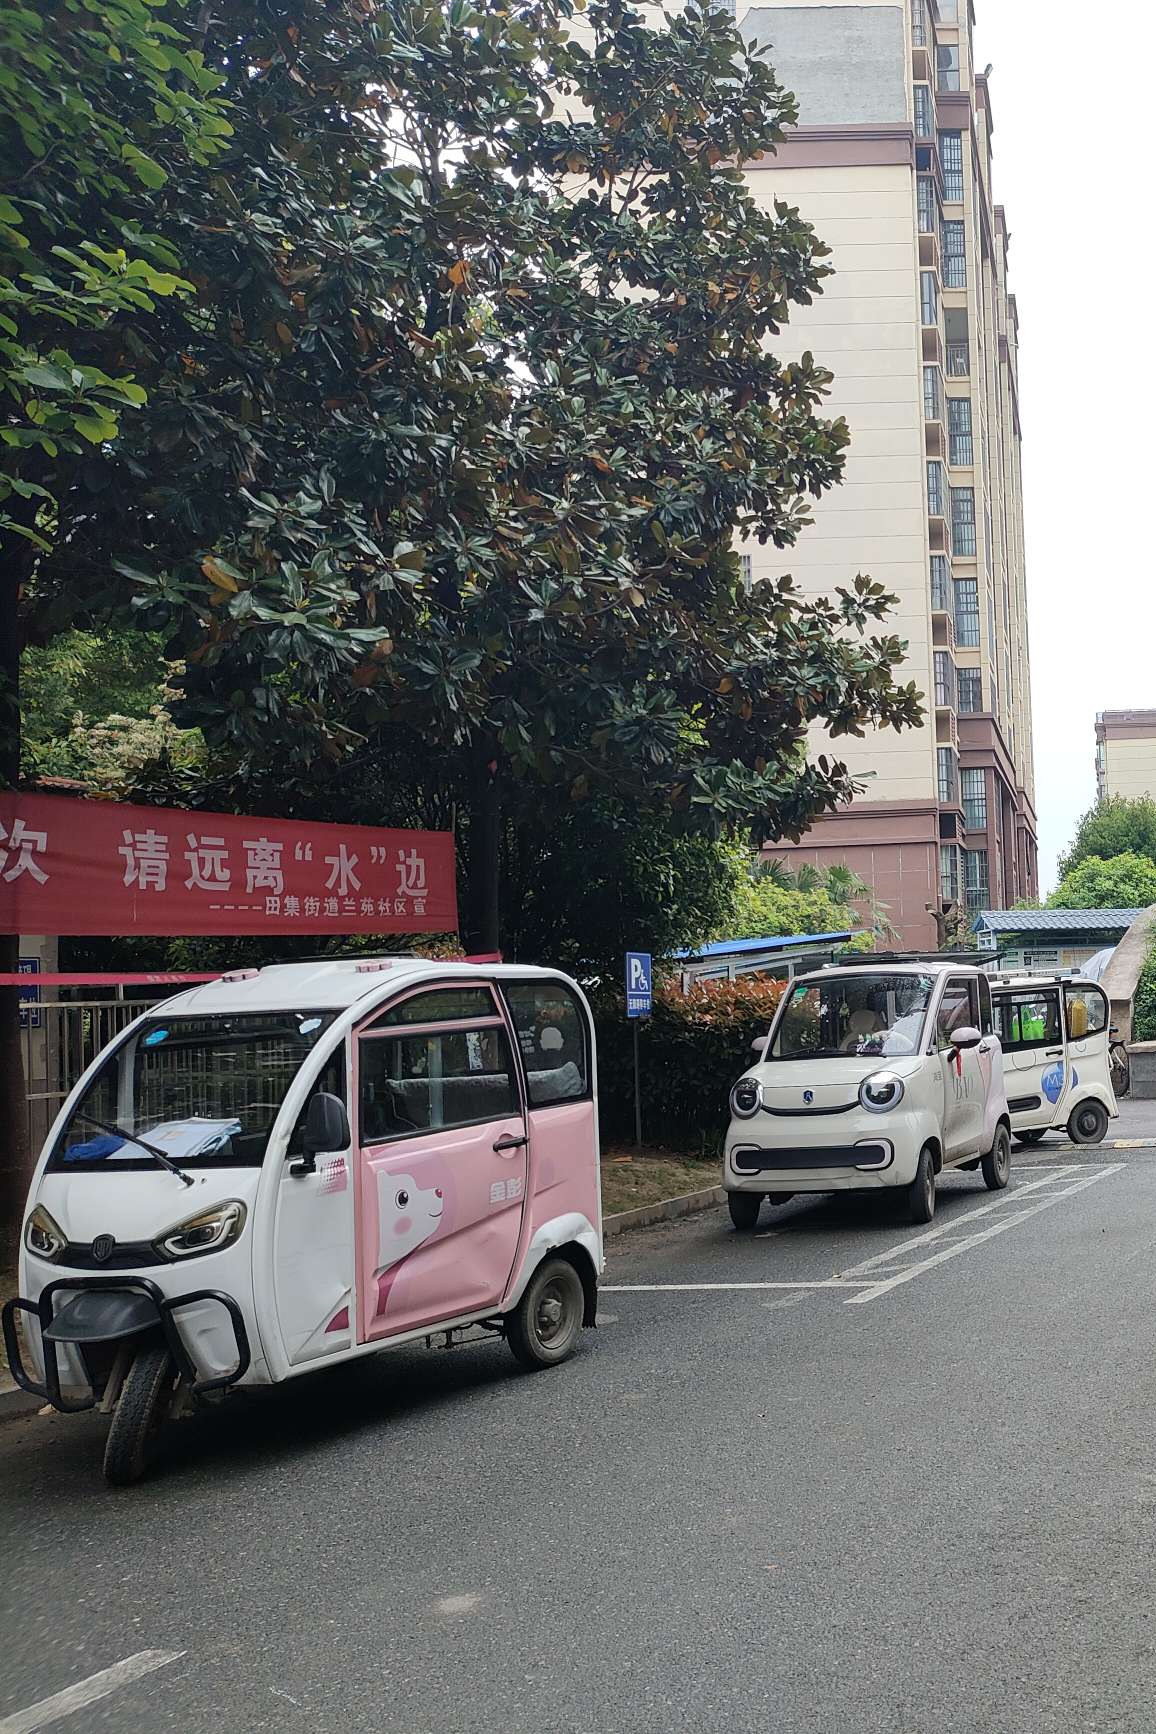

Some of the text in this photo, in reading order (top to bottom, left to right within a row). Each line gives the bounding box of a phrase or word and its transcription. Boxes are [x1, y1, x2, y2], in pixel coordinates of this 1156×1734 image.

[0, 818, 429, 896] 次 请远离“水”边
[631, 958, 641, 989] P
